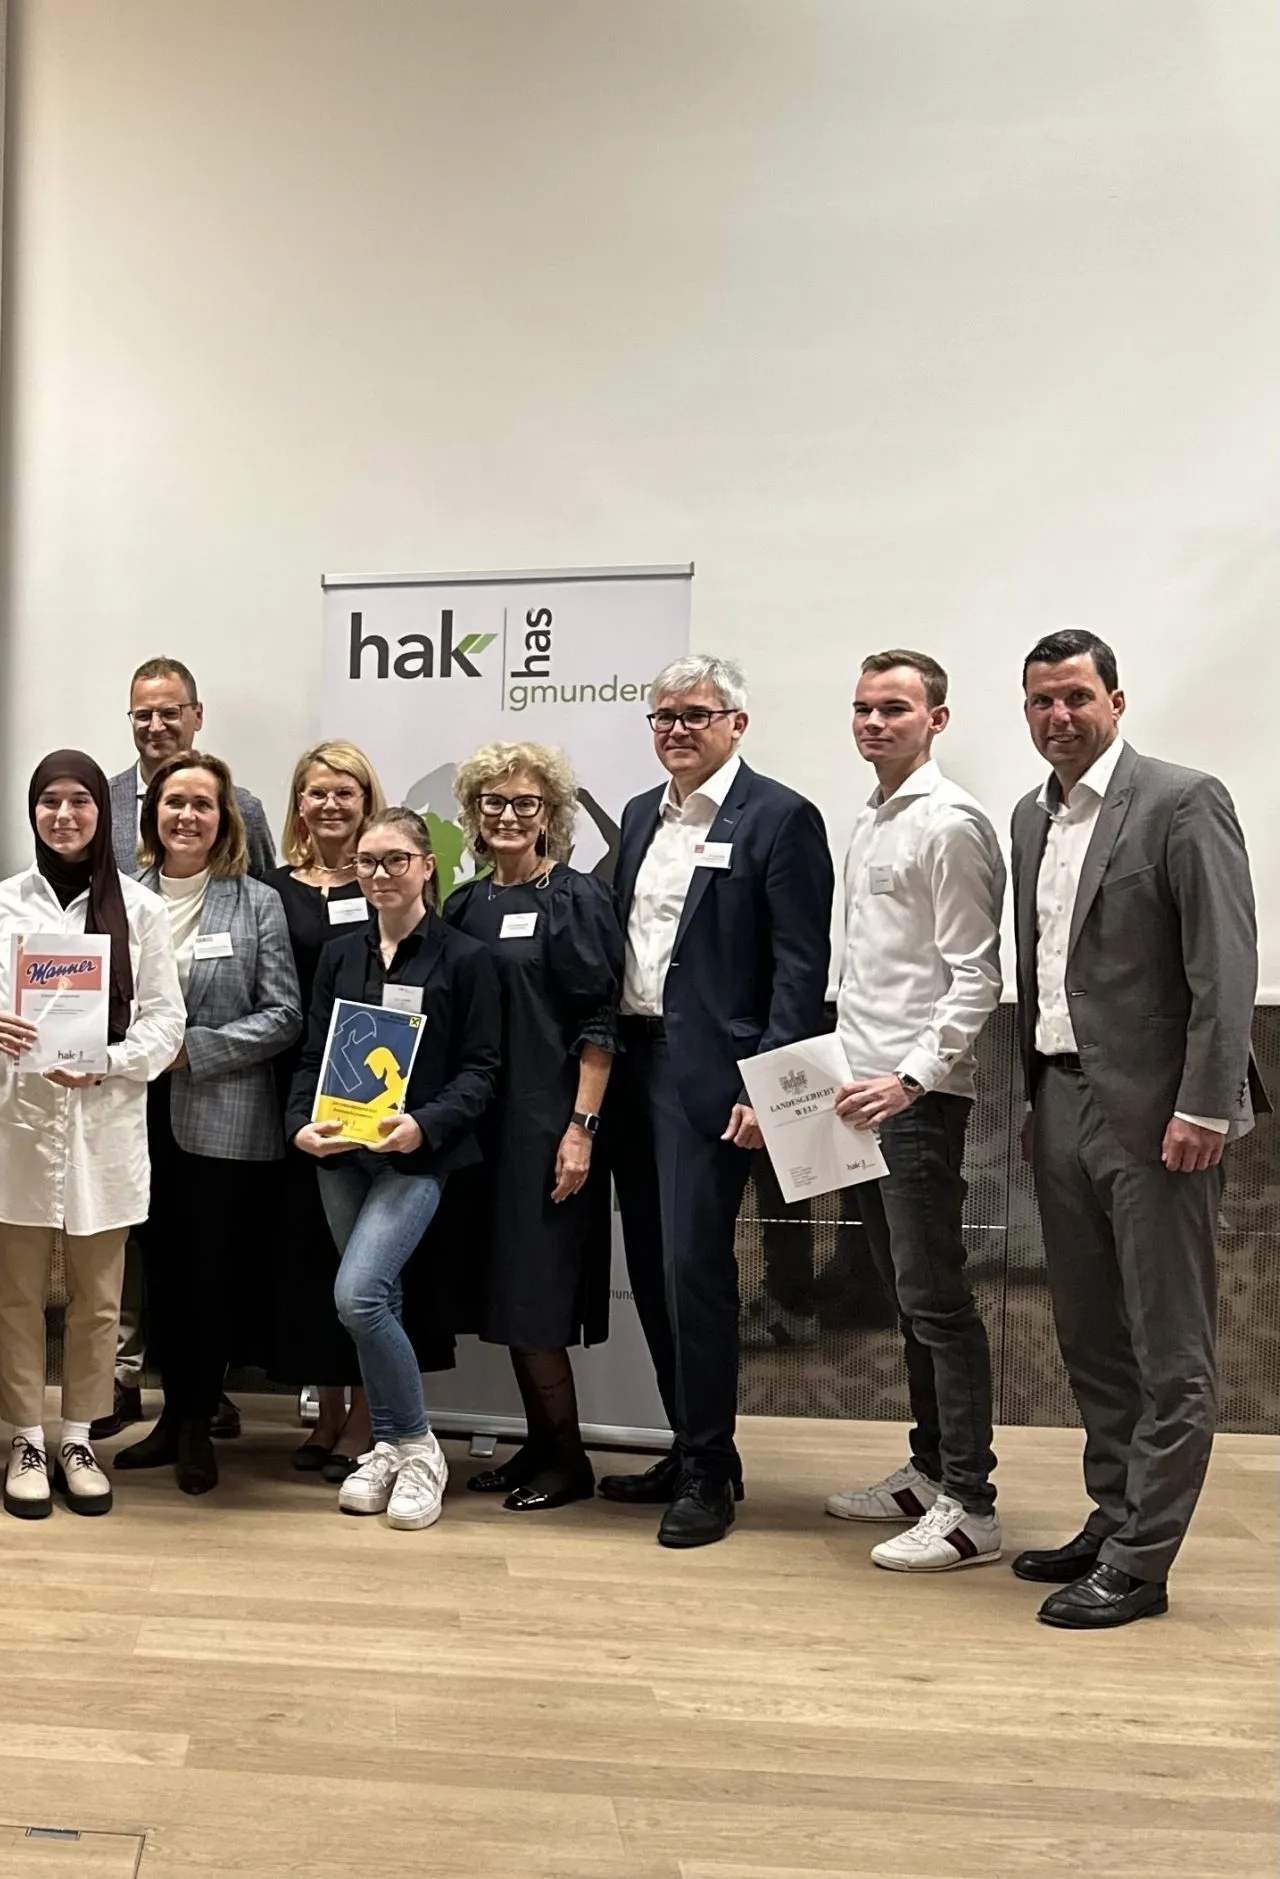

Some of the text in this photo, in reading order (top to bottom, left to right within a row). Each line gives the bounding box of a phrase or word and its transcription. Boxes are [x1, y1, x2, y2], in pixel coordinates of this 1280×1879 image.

[349, 609, 497, 679] hak
[510, 606, 553, 678] has
[27, 960, 96, 985] Manner
[769, 1086, 836, 1113] LANDESGERICHT
[795, 1104, 818, 1116] WELS
